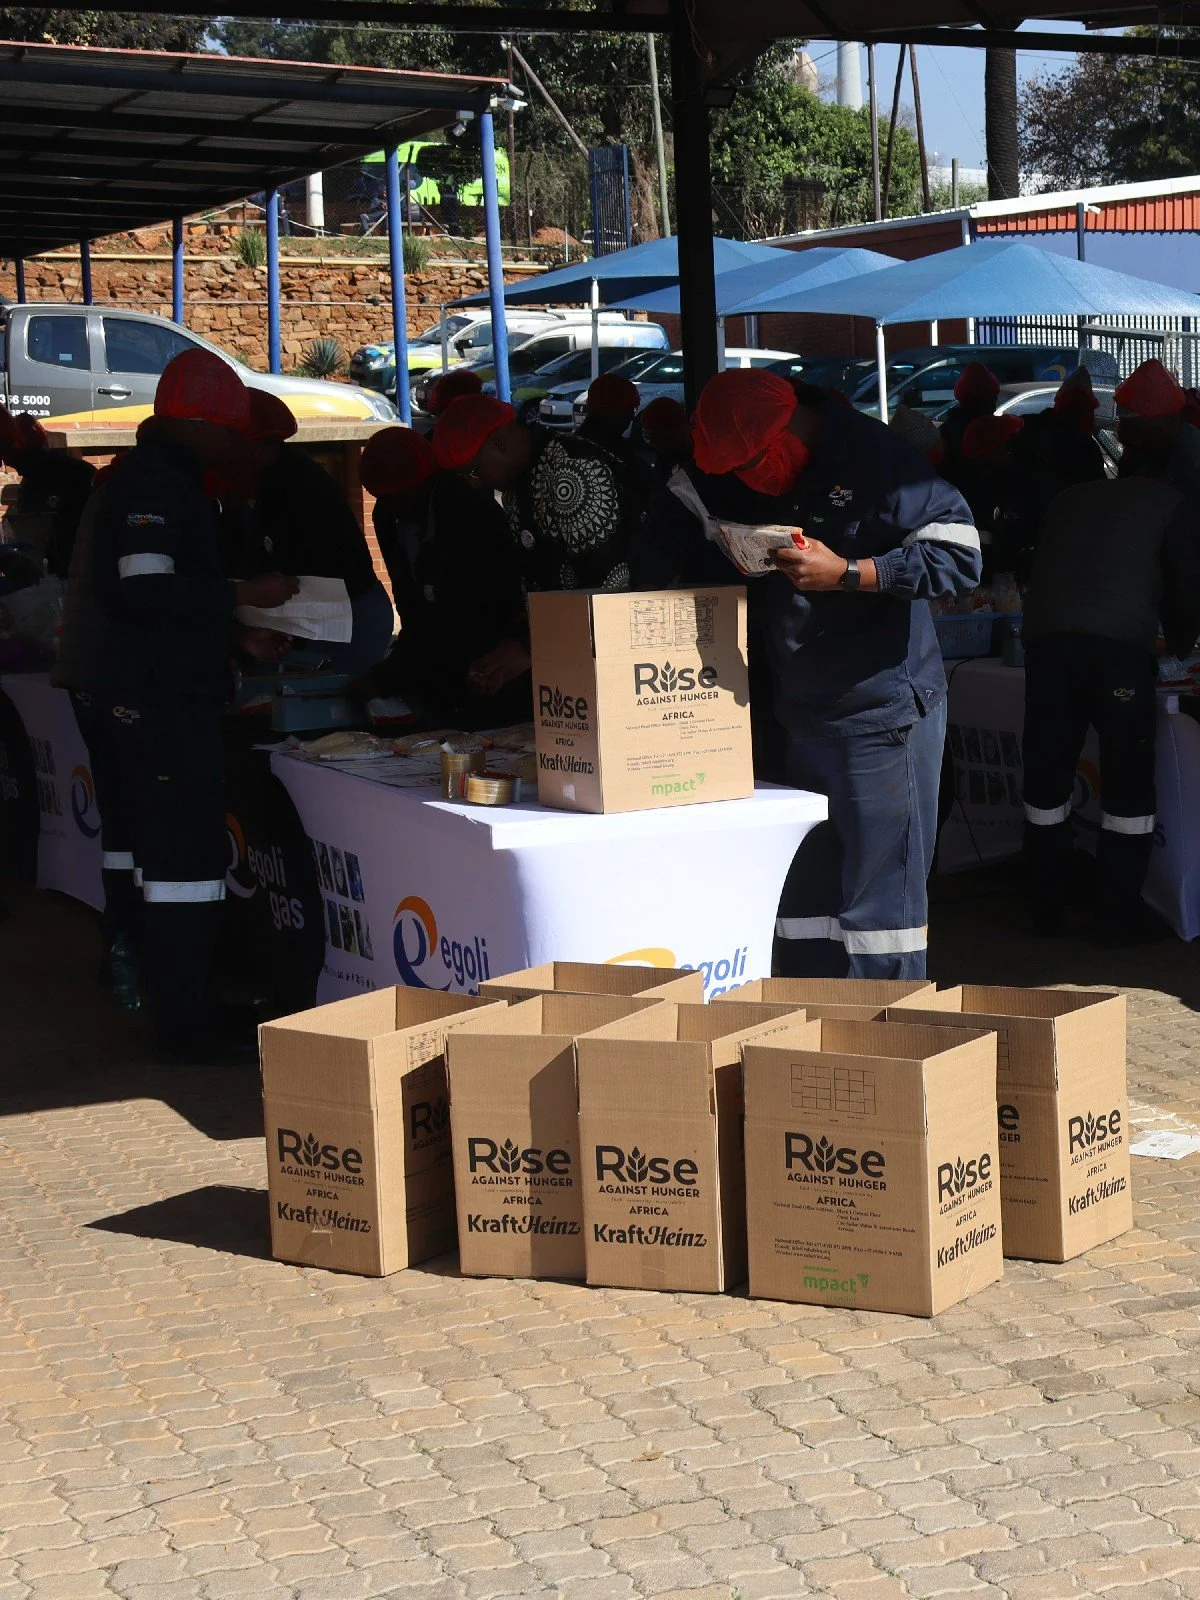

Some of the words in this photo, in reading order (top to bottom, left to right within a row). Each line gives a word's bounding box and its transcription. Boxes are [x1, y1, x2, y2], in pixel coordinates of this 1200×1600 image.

[22, 396, 50, 405] 5000
[634, 660, 718, 695] Rise
[539, 686, 588, 720] Rise
[636, 694, 678, 706] AGAINST
[680, 691, 720, 702] HUNGER
[662, 711, 695, 721] AFRICA
[541, 719, 564, 730] AGAINST
[565, 721, 590, 732] HUNGER
[555, 738, 575, 748] AFRICA
[652, 779, 696, 797] mpact
[248, 845, 286, 888] egoli
[269, 890, 304, 931] gas
[440, 936, 490, 987] egoli
[1000, 1132, 1021, 1143] GER
[1068, 1110, 1121, 1154] Rise
[278, 1128, 362, 1174] Rise
[468, 1137, 572, 1175] Rise
[785, 1132, 886, 1178] Rise
[1071, 1146, 1096, 1166] AGAINST
[1098, 1136, 1122, 1153] HUNGER
[596, 1144, 698, 1186] Rise
[1087, 1162, 1107, 1178] AFRICA
[281, 1166, 321, 1180] AGAINST
[324, 1172, 364, 1186] HUNGER
[472, 1176, 520, 1186] AGAINST
[524, 1176, 573, 1188] HUNGER
[787, 1172, 836, 1186] AGAINST
[840, 1178, 887, 1192] HUNGER
[938, 1153, 992, 1204] Rise
[306, 1188, 339, 1200] AFRICA
[598, 1184, 648, 1196] AGAINST
[652, 1187, 700, 1198] HUNGER
[940, 1194, 966, 1216] AGAINST
[968, 1180, 992, 1200] HUNGER
[502, 1196, 542, 1206] AFRICA
[816, 1196, 856, 1208] AFRICA
[629, 1205, 669, 1216] AFRICA
[956, 1210, 976, 1227] AFRICA
[804, 1276, 858, 1293] mpact
